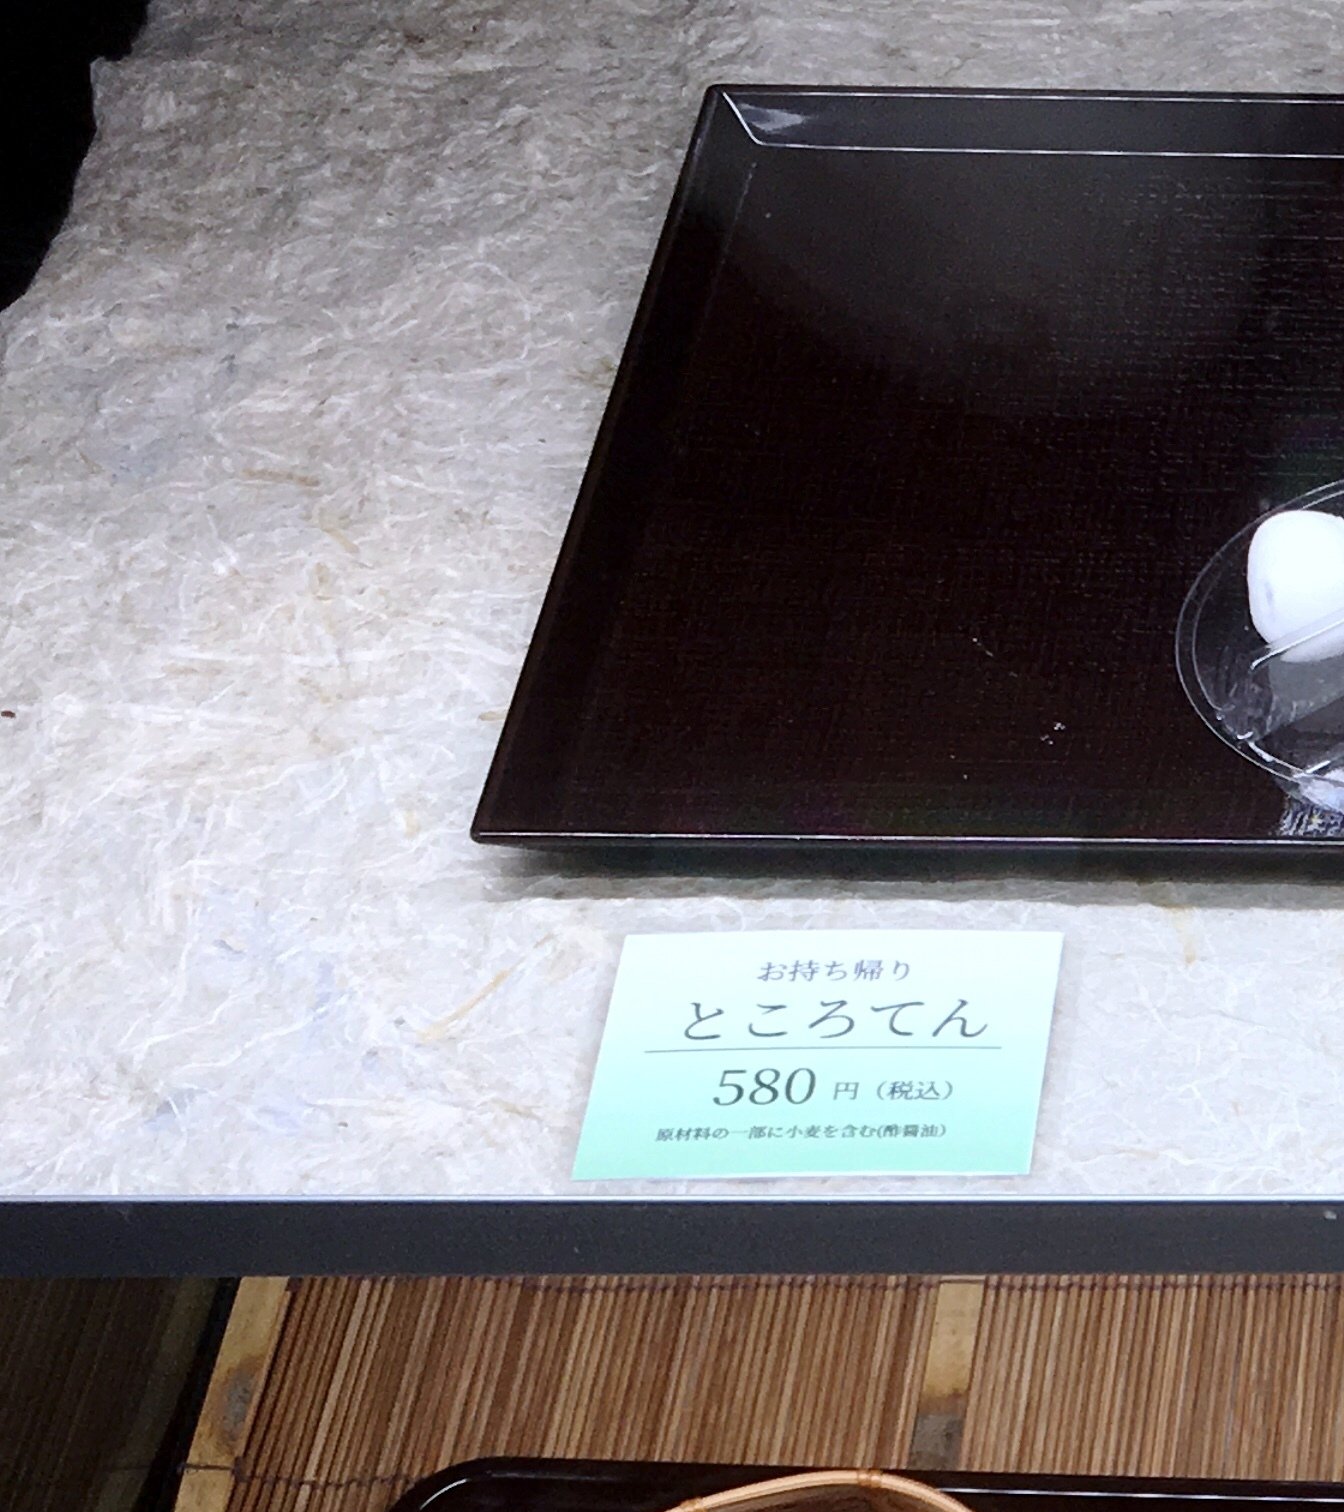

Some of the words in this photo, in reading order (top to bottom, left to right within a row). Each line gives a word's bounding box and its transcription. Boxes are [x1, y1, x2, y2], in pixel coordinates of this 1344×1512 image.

[757, 960, 910, 982] お持ち帰り
[683, 999, 988, 1040] ところてん
[713, 1068, 817, 1106] 580
